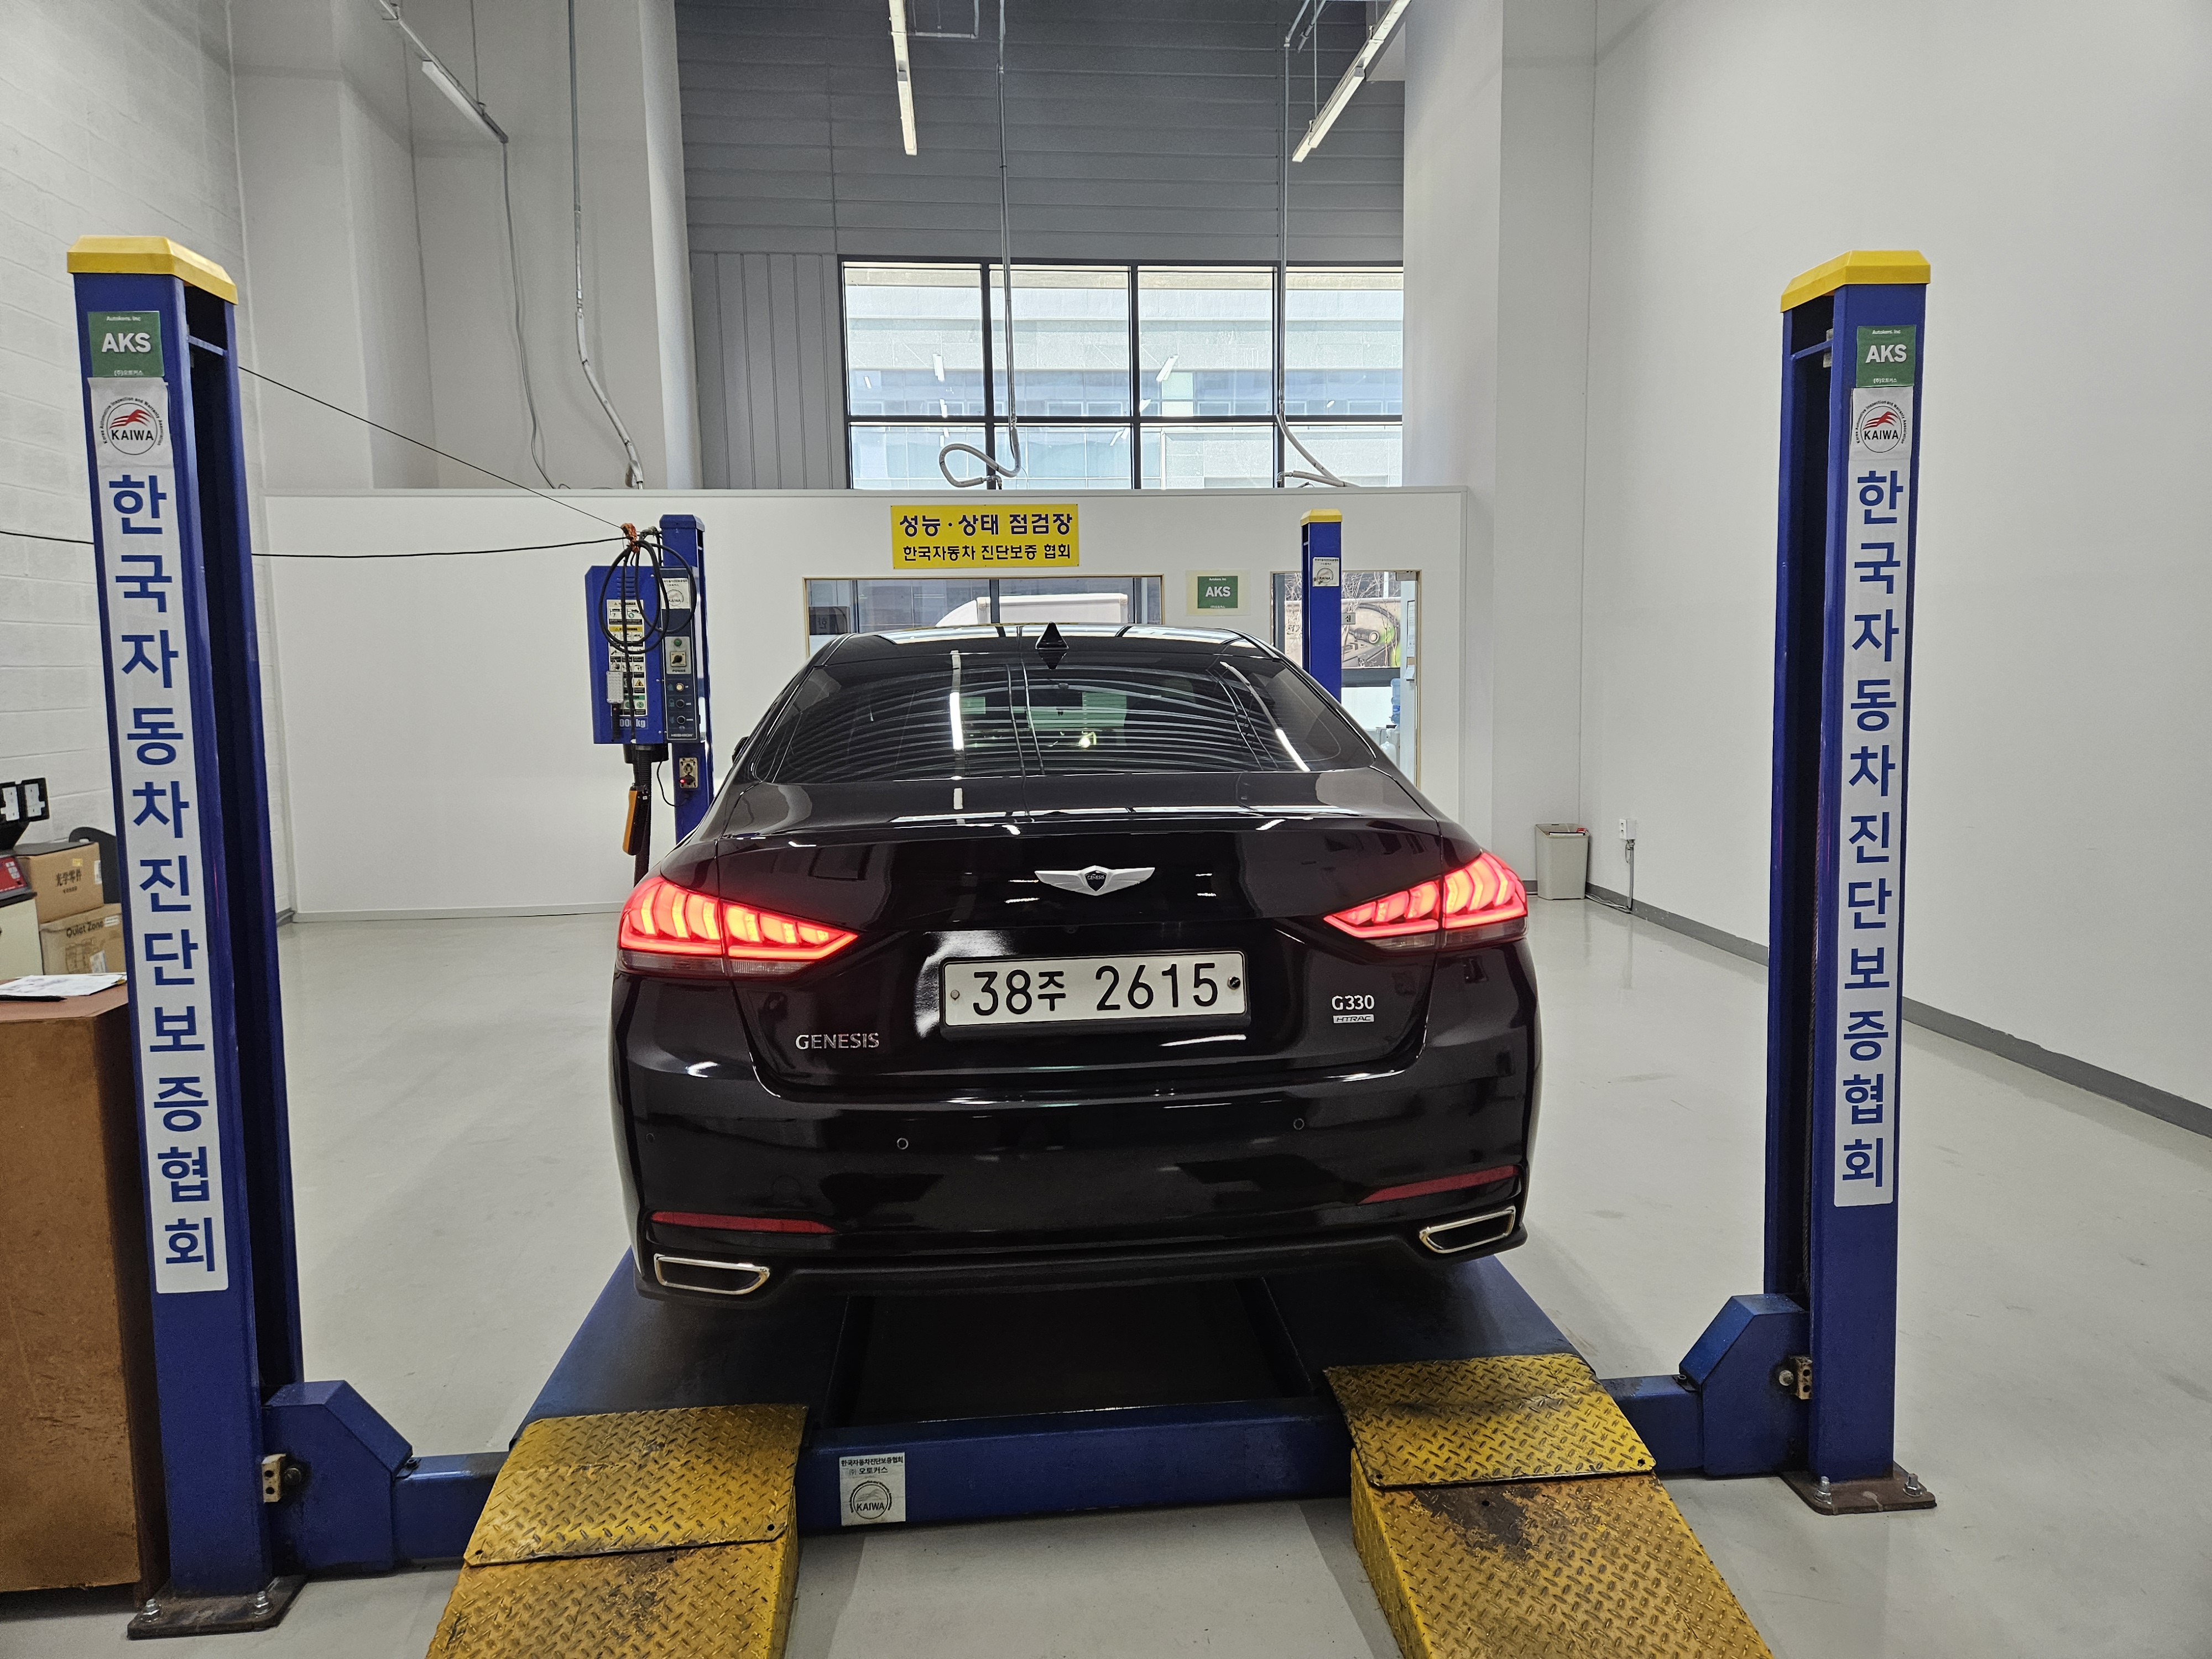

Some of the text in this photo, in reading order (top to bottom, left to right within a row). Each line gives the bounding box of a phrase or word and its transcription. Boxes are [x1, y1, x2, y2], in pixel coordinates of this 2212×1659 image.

[102, 332, 151, 352] AKS
[1865, 344, 1907, 363] AKS
[111, 430, 154, 441] KAIWA
[1864, 430, 1898, 440] KAIWA
[1009, 513, 1072, 535] 점검장
[903, 544, 1071, 561] 한국자동차 진단보증 협회
[1205, 586, 1230, 597] AKS
[1842, 469, 1904, 1187] 한국자동차진단보증협회
[108, 474, 215, 1272] 한국자동차진단보증협회
[972, 962, 1218, 1016] 38주 2615
[1332, 995, 1375, 1011] G330
[795, 1032, 880, 1050] GENESIS
[841, 1455, 904, 1467] 한국자동차진단보증협회
[856, 1502, 885, 1511] KAIWA
